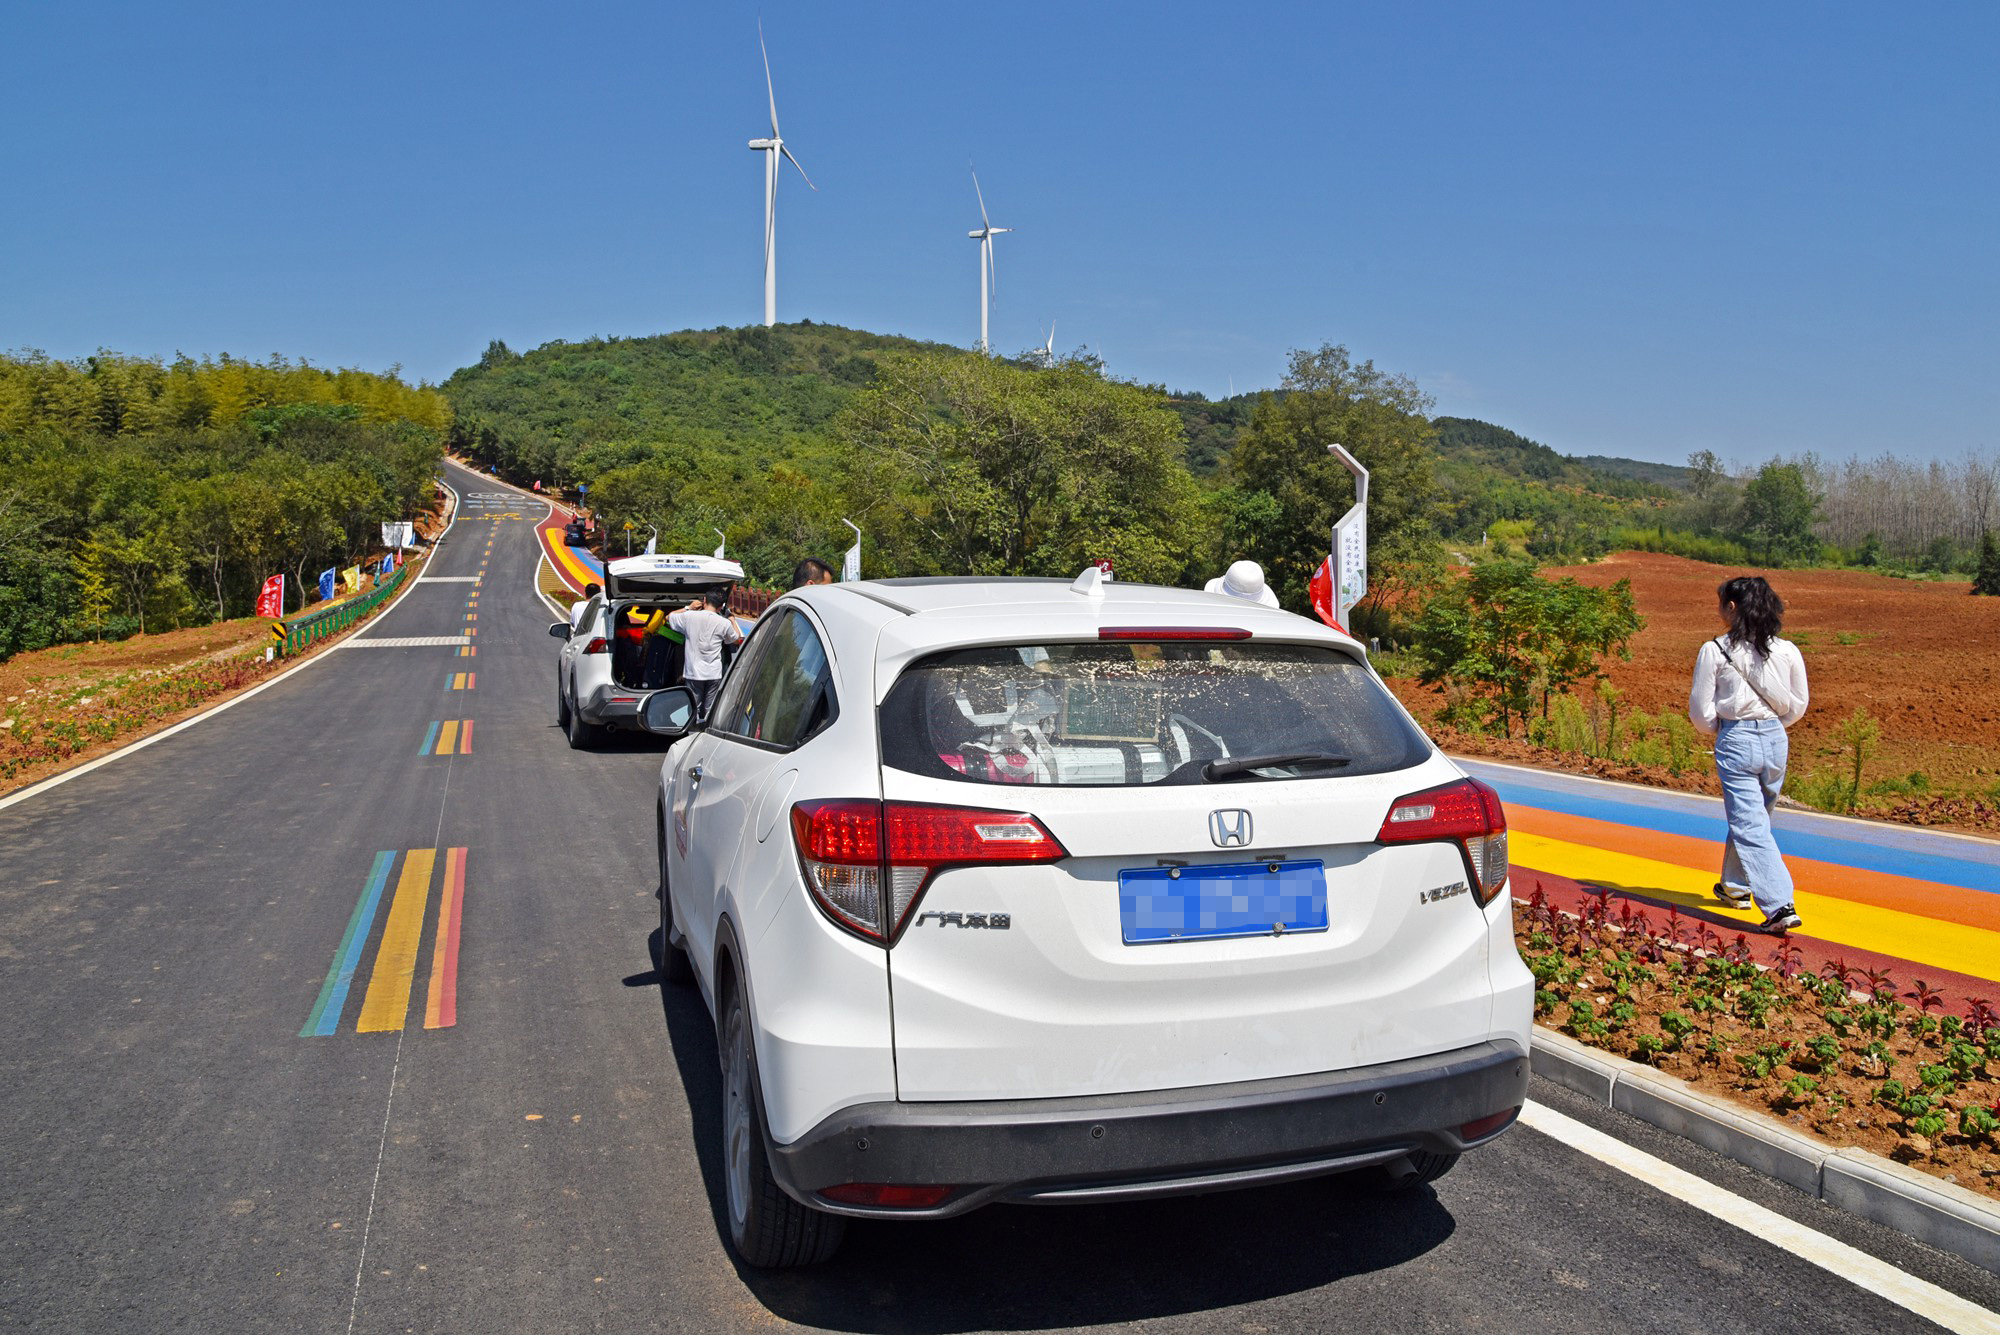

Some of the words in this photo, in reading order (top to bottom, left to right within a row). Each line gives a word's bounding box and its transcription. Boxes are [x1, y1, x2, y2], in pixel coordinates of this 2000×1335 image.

[1420, 881, 1468, 905] VEZEL
[915, 911, 1011, 930] 广汽本田
